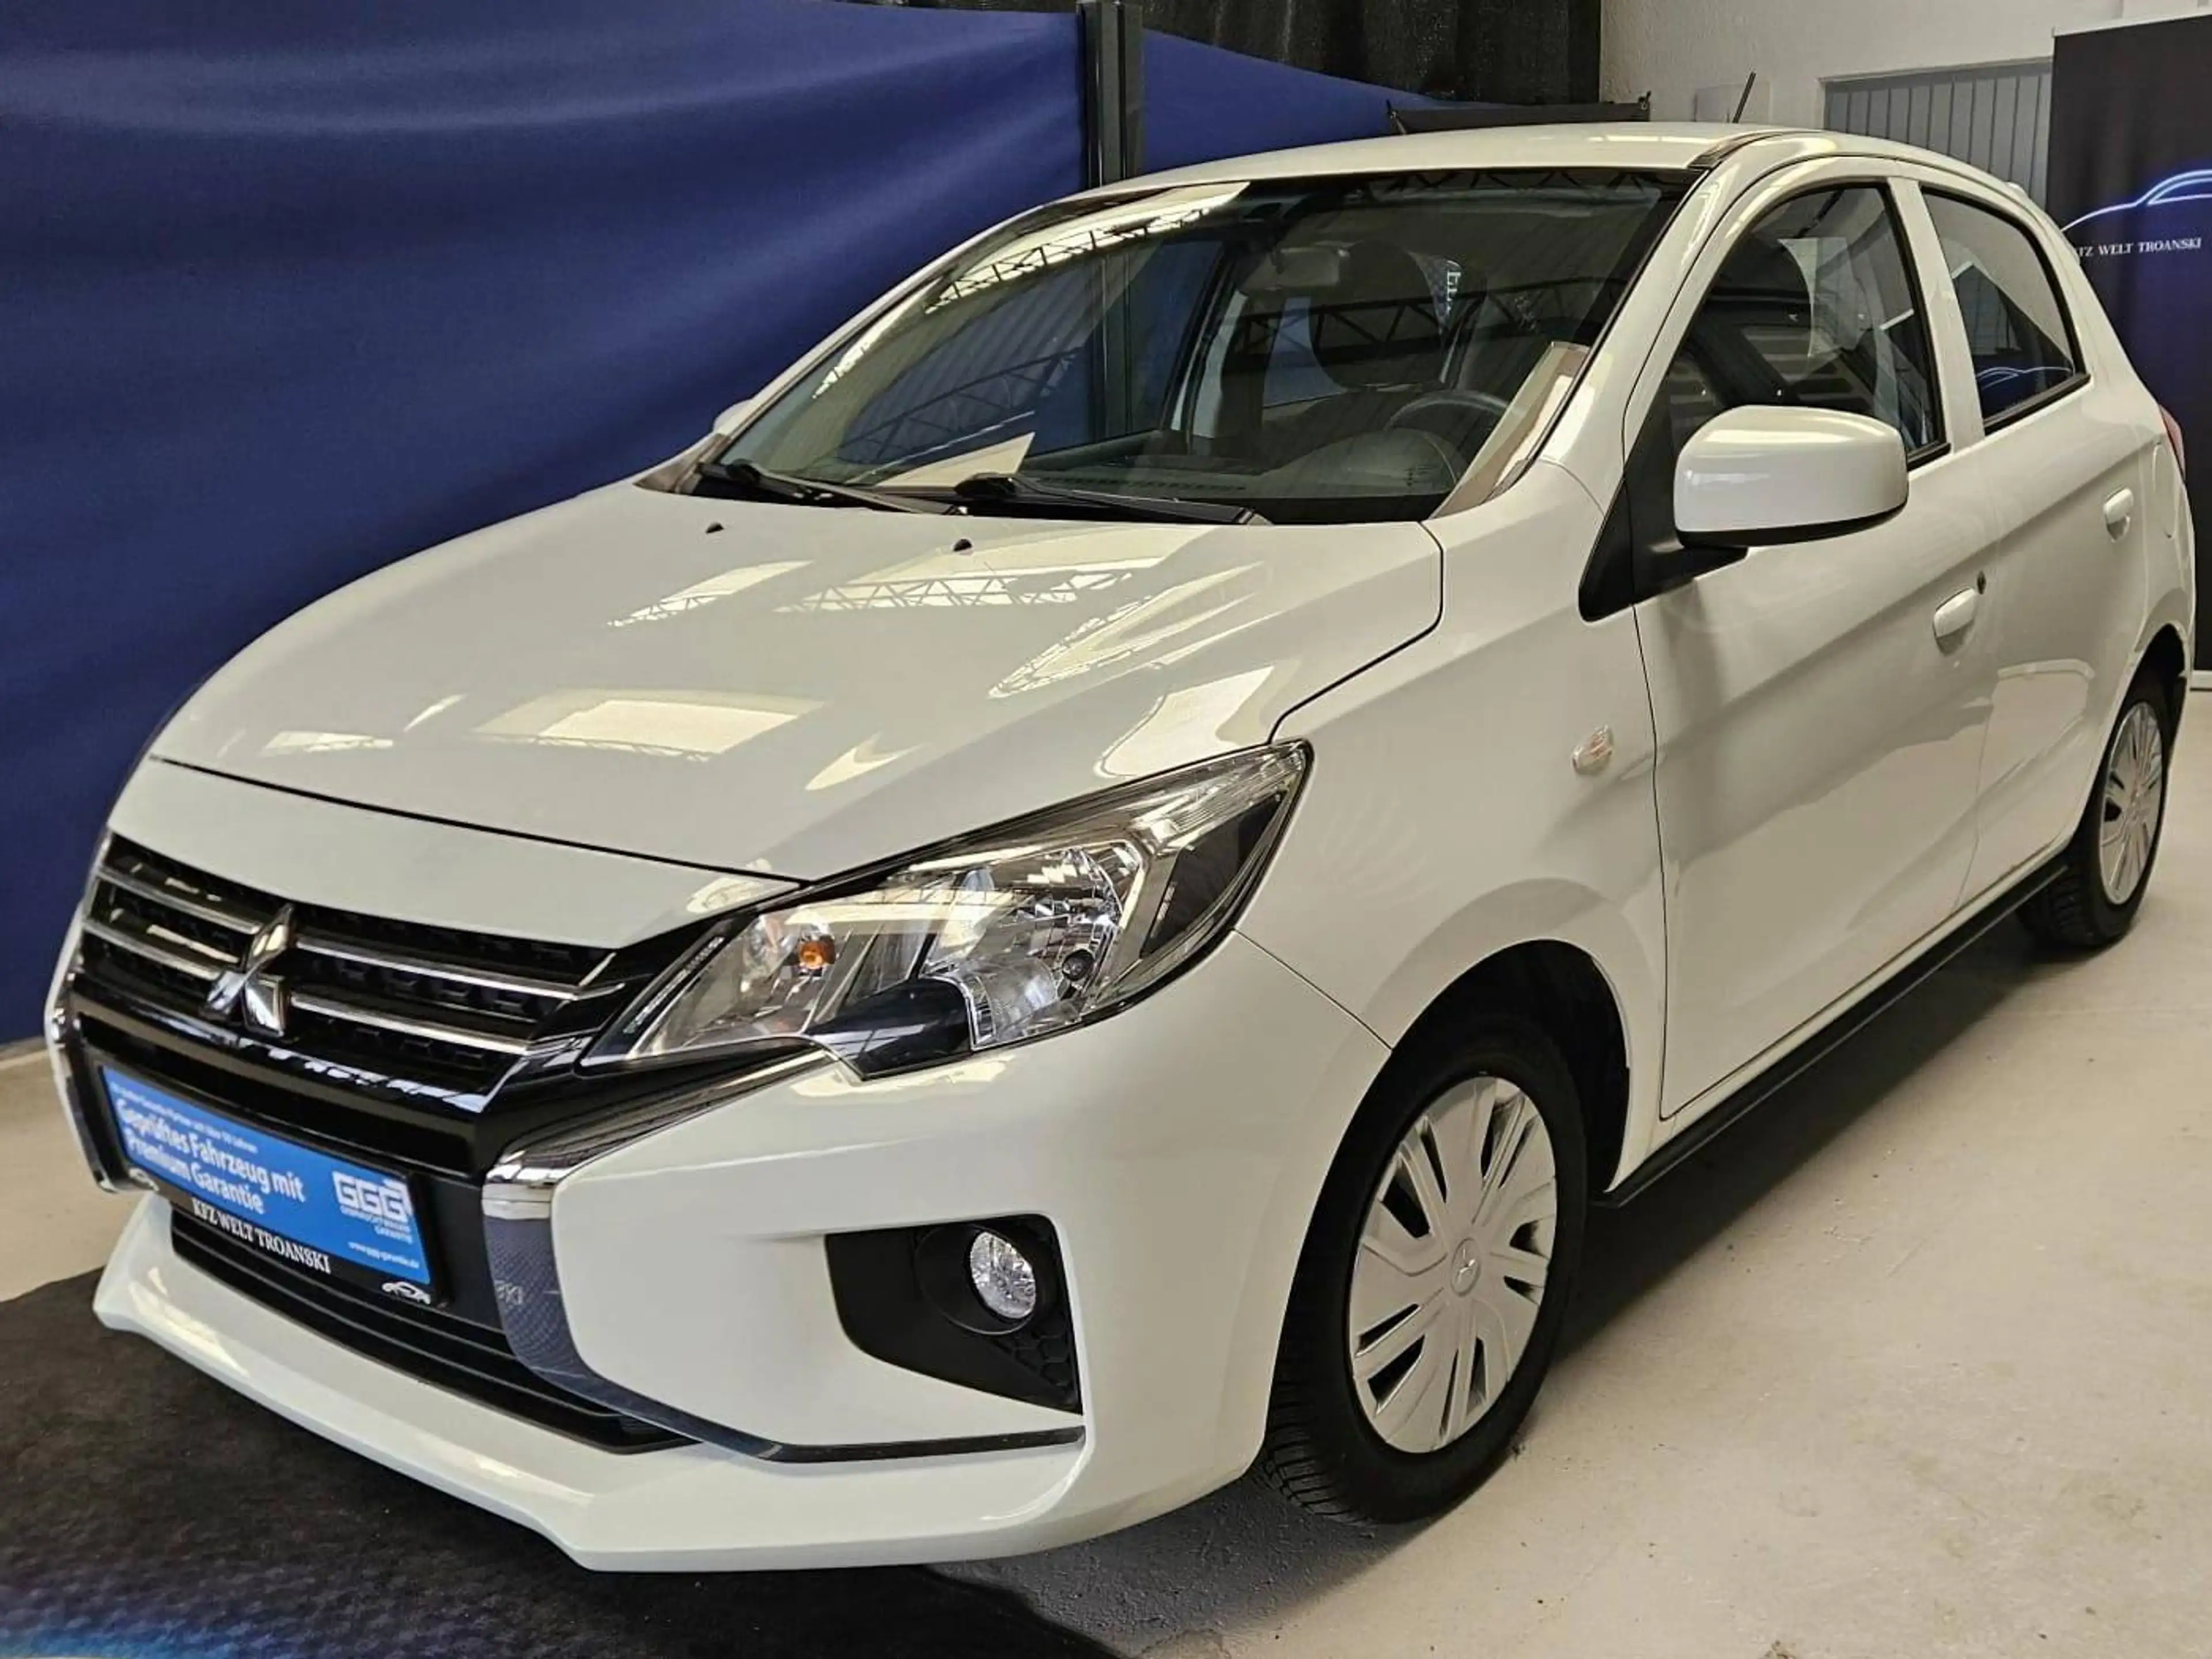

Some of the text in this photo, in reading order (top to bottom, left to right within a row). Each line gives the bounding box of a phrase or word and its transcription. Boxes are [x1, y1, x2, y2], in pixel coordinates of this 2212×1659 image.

[2097, 242, 2134, 255] WELT
[2138, 237, 2202, 252] TROANSKI
[124, 1126, 265, 1215] Premium Garantie
[188, 1132, 270, 1195] Fahrzeug
[271, 1171, 306, 1203] mit
[332, 1171, 409, 1224] GGG
[191, 1197, 218, 1225] KFZ
[217, 1210, 254, 1243] WELT
[254, 1227, 331, 1275] TROANSKI
